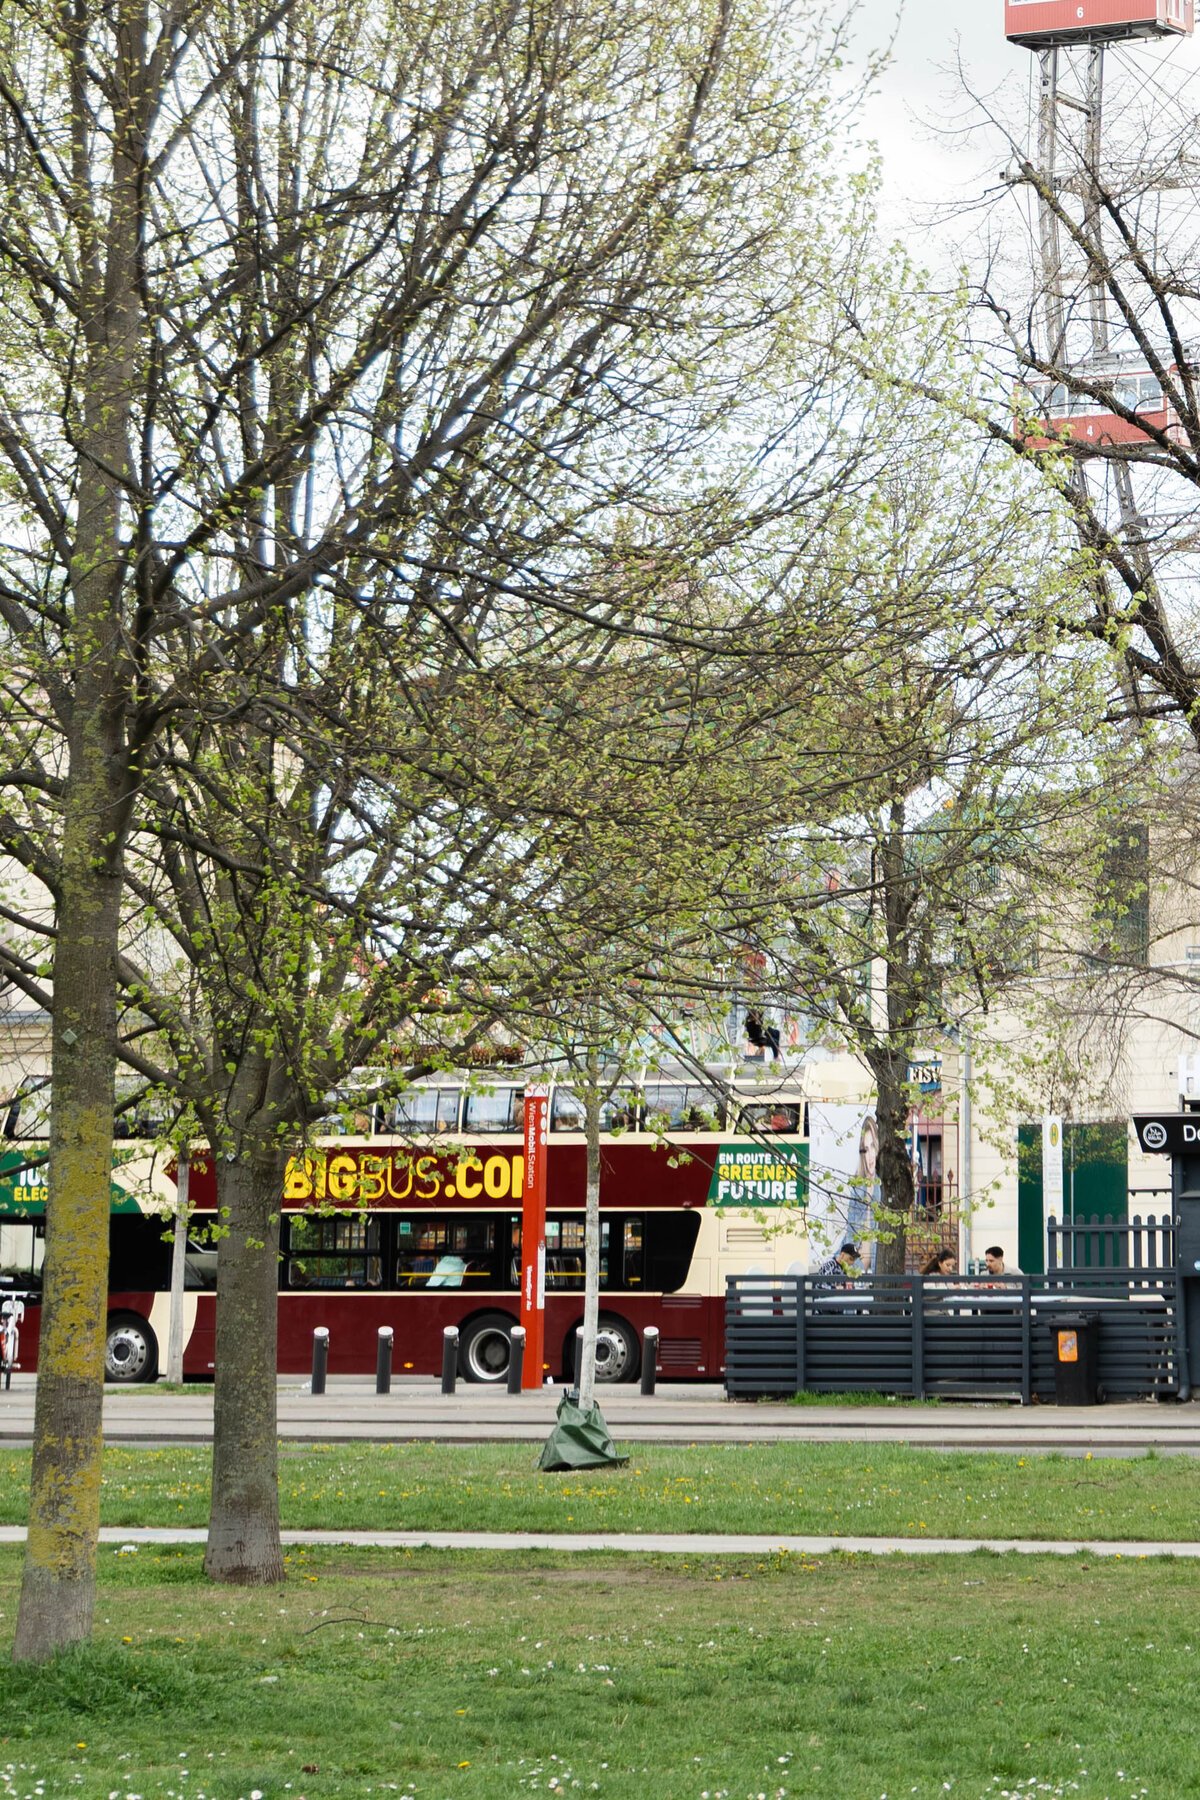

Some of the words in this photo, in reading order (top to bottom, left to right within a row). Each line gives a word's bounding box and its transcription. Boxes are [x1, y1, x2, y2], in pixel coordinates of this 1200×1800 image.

[1076, 6, 1084, 18] 6
[1086, 425, 1093, 436] 4
[718, 1153, 733, 1165] EN
[736, 1153, 772, 1165] ROUTE
[790, 1153, 798, 1164] A
[527, 1155, 536, 1189] Station
[718, 1165, 798, 1181] GREENER
[717, 1181, 798, 1200] FUTURE
